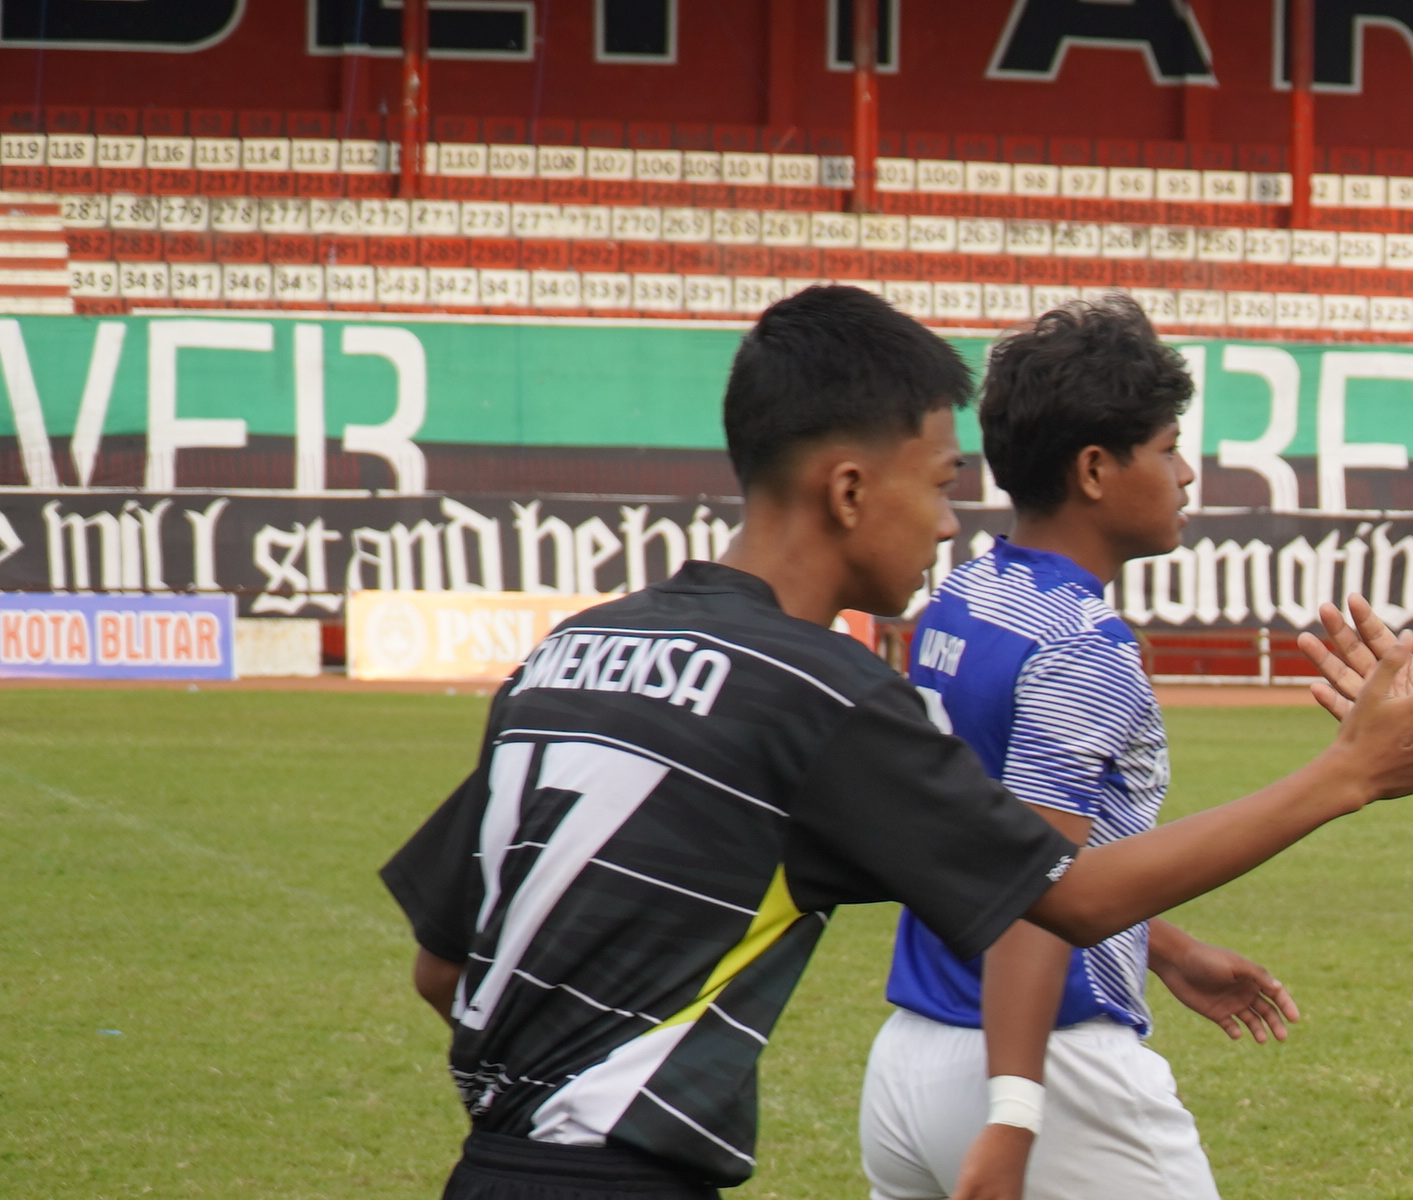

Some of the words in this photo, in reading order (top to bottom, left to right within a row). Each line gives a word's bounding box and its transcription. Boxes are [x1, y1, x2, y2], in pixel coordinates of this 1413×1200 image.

[5, 141, 39, 159] 119
[51, 141, 85, 160] 118
[101, 143, 136, 161] 117
[151, 144, 184, 162] 116
[200, 146, 234, 163] 115
[247, 146, 280, 164] 114
[296, 147, 329, 165] 113
[345, 147, 377, 165] 112
[445, 150, 479, 168] 110
[492, 151, 529, 169] 109
[542, 154, 575, 170] 108
[593, 155, 626, 172] 107
[641, 156, 675, 173] 106
[684, 157, 720, 176] 105
[779, 161, 812, 180] 103
[924, 166, 958, 185] 100
[1071, 174, 1098, 192] 97
[1120, 175, 1145, 192] 96
[1167, 176, 1191, 193] 95
[1212, 178, 1236, 196] 94
[1350, 183, 1372, 200] 91
[64, 203, 105, 220] 281
[163, 205, 202, 223] 279
[213, 206, 252, 224] 278
[264, 206, 302, 224] 277
[365, 207, 403, 226] 275
[467, 210, 503, 228] 273
[617, 215, 656, 232] 270
[666, 215, 704, 233] 269
[763, 218, 802, 236] 267
[815, 219, 852, 238] 266
[865, 221, 901, 240] 265
[912, 224, 947, 241] 264
[963, 225, 998, 243] 263
[1297, 236, 1331, 254] 256
[1342, 238, 1375, 256] 255
[72, 272, 112, 291] 349
[123, 272, 164, 291] 348
[173, 272, 213, 291] 347
[226, 274, 265, 292] 346
[278, 274, 316, 291] 345
[330, 274, 368, 292] 344
[433, 276, 471, 295] 342
[535, 279, 575, 297] 340
[639, 281, 677, 300] 338
[686, 283, 725, 301] 337
[1184, 296, 1220, 316] 327
[1280, 299, 1315, 319] 325
[1, 613, 87, 663] KOTA
[100, 612, 222, 663] BLITAR
[436, 608, 536, 664] PSSI
[451, 741, 672, 1031] 17
